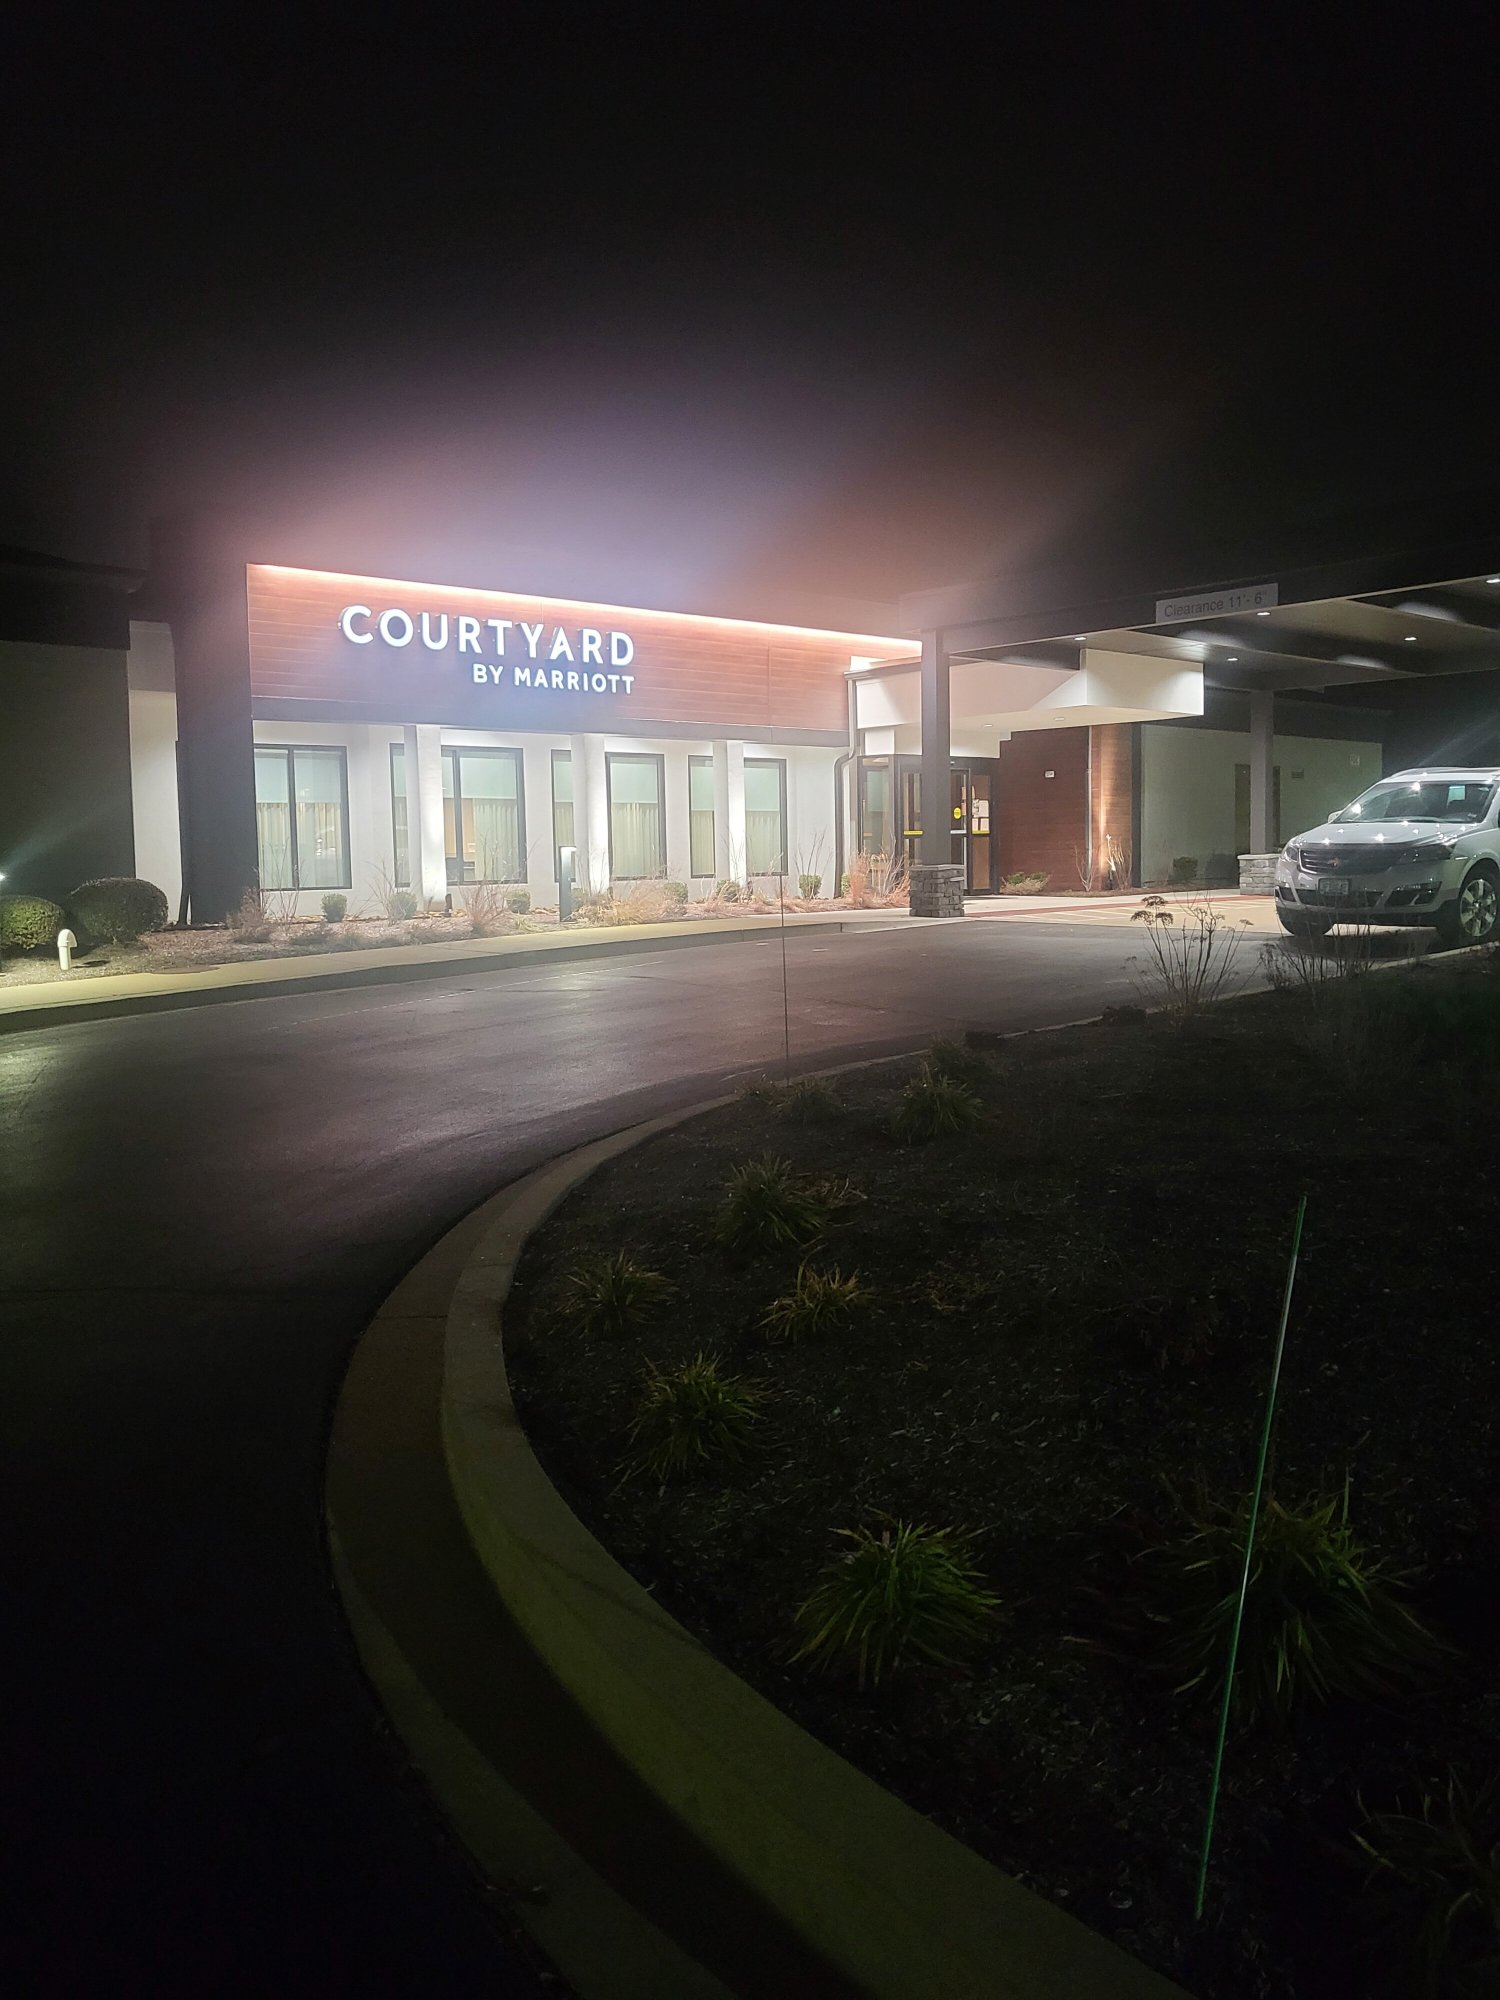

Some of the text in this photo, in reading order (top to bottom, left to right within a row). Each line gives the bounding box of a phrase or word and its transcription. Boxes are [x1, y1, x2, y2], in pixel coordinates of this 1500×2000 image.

[1164, 601, 1224, 617] Clearance
[340, 605, 635, 666] COURTYARD
[473, 664, 635, 694] BY MARRIOTT
